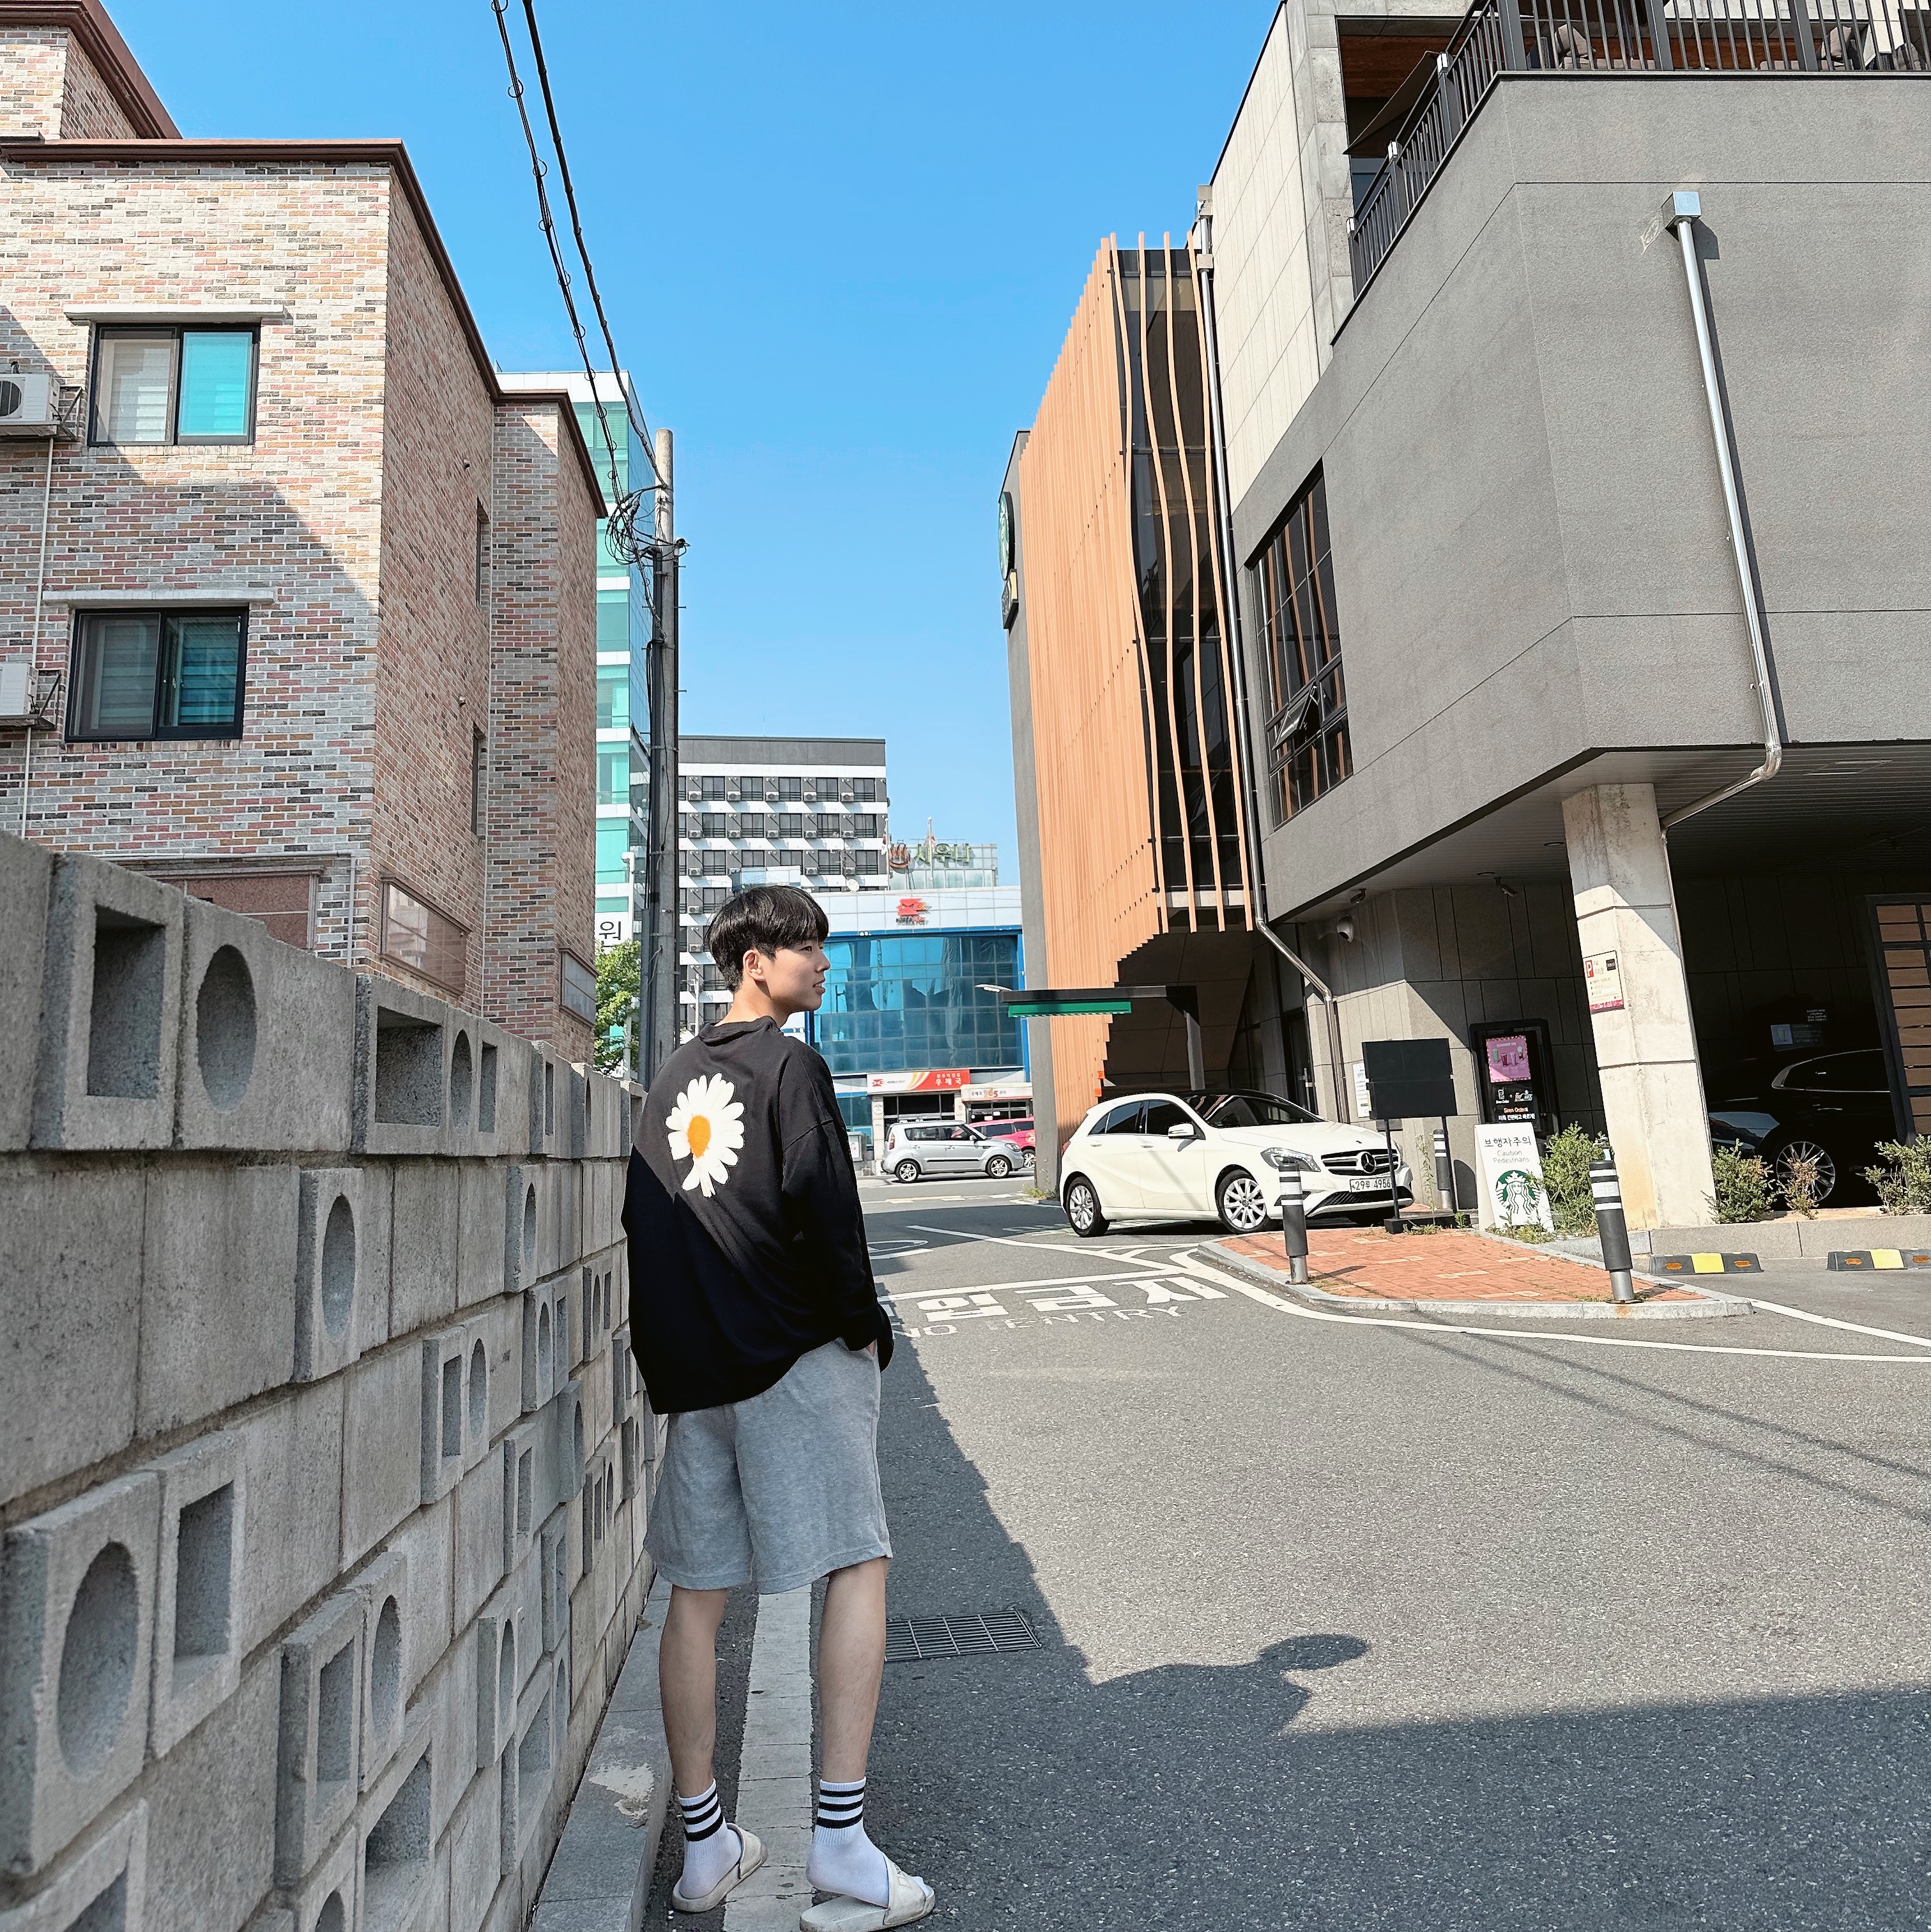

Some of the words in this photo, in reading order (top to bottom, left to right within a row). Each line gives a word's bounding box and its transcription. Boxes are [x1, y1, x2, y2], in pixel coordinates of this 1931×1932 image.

[1485, 1136, 1532, 1148] 보행자주의
[1373, 1178, 1391, 1189] 4956
[1002, 1305, 1181, 1329] ENTRY
